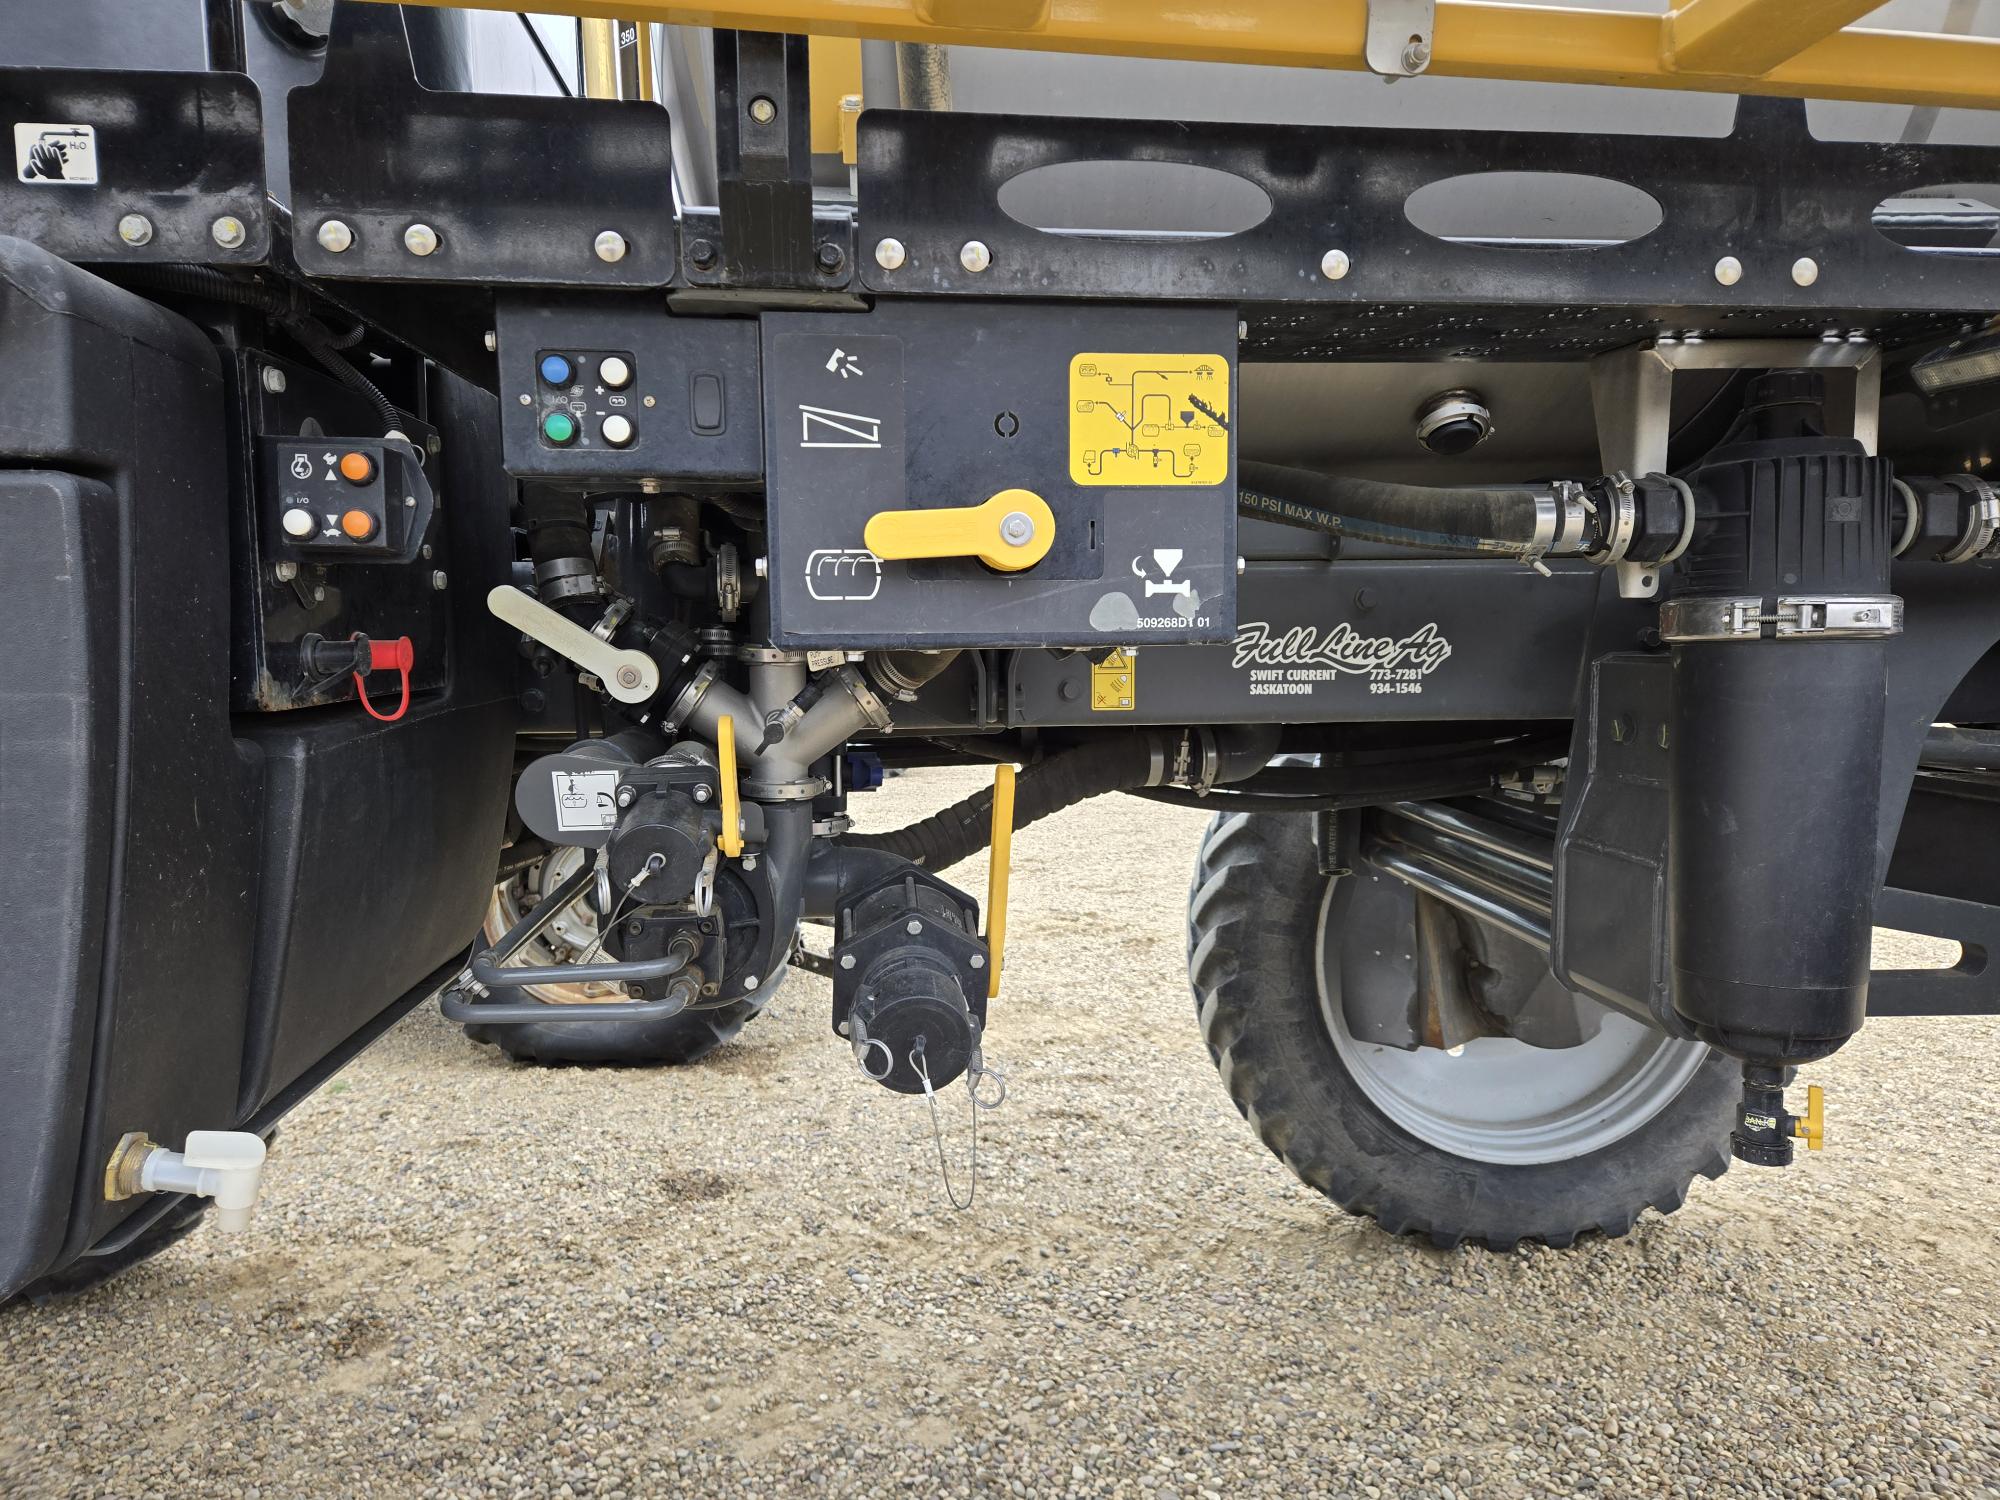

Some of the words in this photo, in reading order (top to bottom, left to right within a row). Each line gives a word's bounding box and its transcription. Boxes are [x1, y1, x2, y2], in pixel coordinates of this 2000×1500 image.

[621, 27, 635, 45] 350
[1239, 491, 1258, 506] 150
[1261, 497, 1281, 513] PSI
[1285, 503, 1313, 521] MAX
[1316, 511, 1343, 528] W.P.
[1136, 617, 1194, 629] 509268D1
[1197, 617, 1210, 628] 01
[1232, 621, 1318, 669] Full
[1310, 622, 1395, 674] Line
[1384, 622, 1451, 674] Ag
[811, 655, 834, 667] PRESSURE
[1250, 669, 1283, 681] SWIFT
[1287, 669, 1337, 681] CURRENT
[1370, 668, 1422, 681] 773-7281
[1250, 683, 1312, 695] SASKATOON
[1370, 682, 1422, 694] 934-1546
